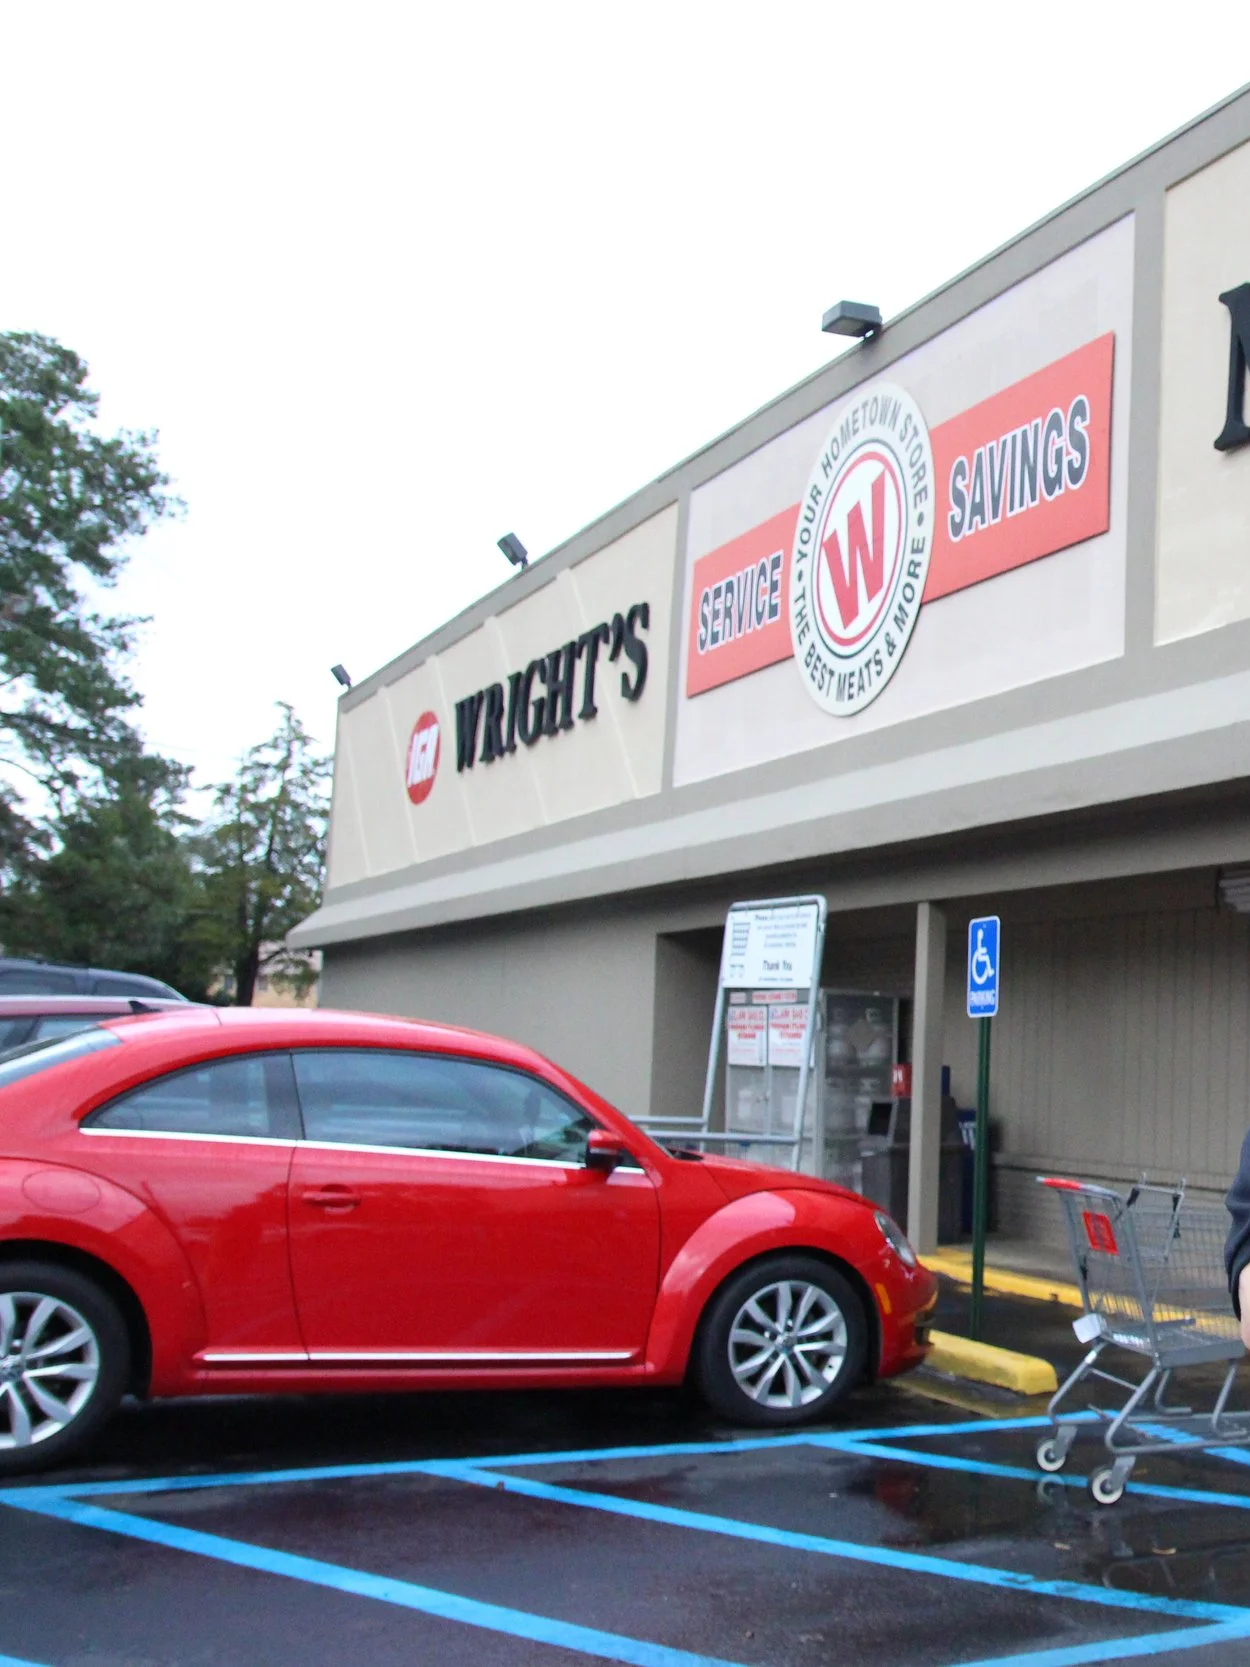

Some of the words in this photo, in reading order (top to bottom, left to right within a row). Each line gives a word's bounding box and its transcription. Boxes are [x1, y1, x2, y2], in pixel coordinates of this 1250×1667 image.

[796, 484, 822, 563] YOUR
[821, 395, 901, 478] HOMETOWN
[899, 412, 928, 509] STORE
[822, 467, 885, 630] W
[949, 395, 1089, 541] SAVINGS
[699, 550, 783, 653] SERVICE
[794, 586, 810, 645] THE
[804, 640, 835, 697] BEST
[835, 649, 883, 702] MEATS
[884, 632, 897, 657] &
[893, 536, 925, 633] MORE
[455, 602, 650, 773] WRIGHT'S
